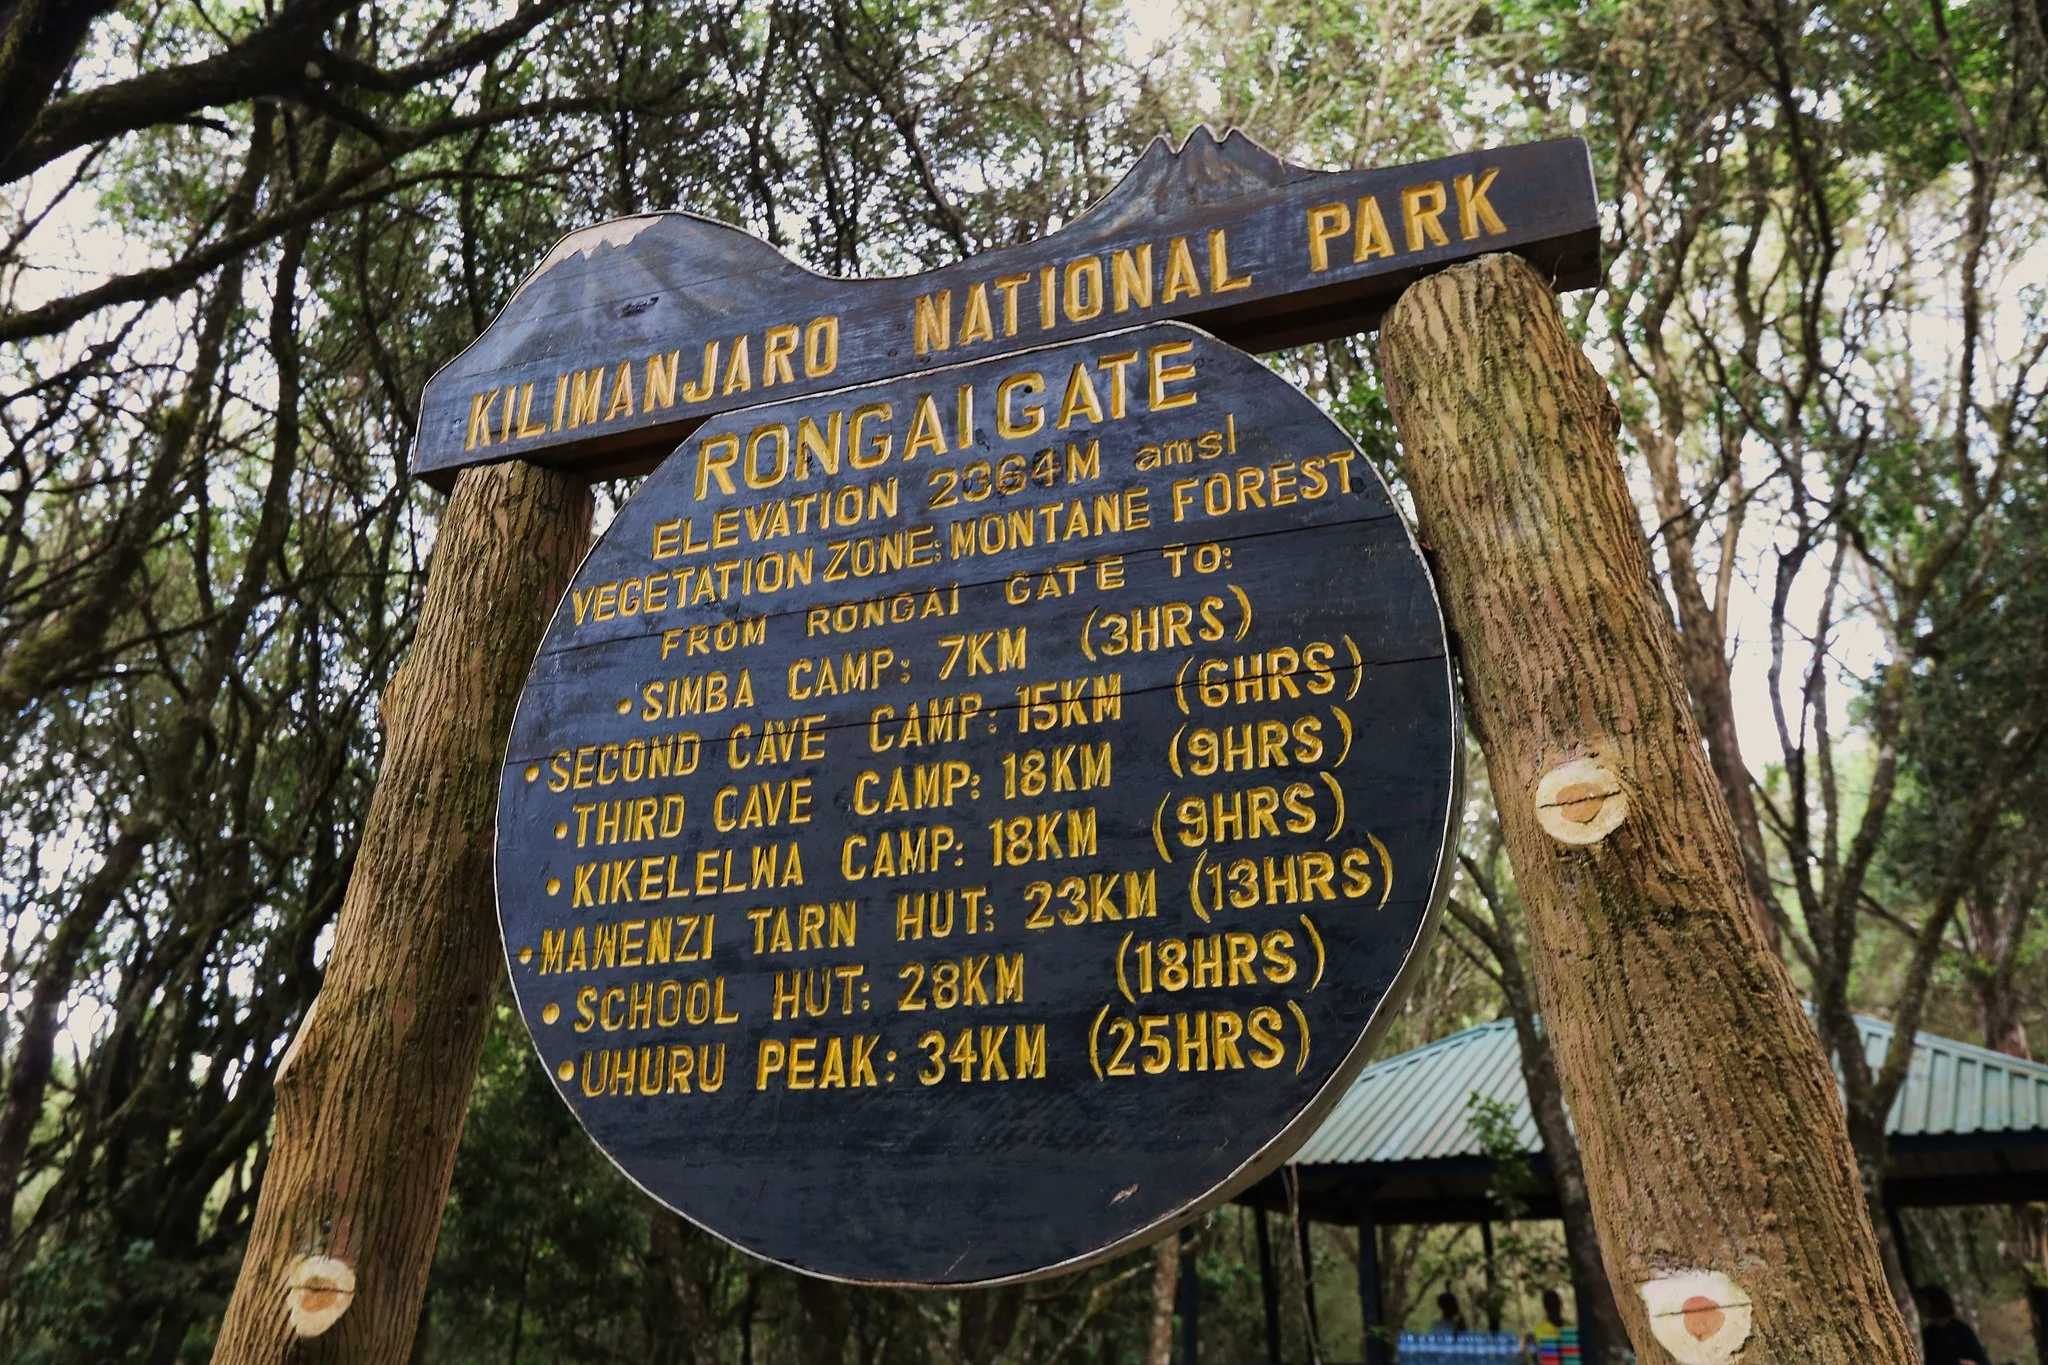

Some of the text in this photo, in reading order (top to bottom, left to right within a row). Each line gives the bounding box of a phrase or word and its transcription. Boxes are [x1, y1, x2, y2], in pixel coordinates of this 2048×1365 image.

[466, 167, 1506, 451] KILIMANJARO NATIONAL PARK
[569, 451, 1355, 628] VEGETATION ZONE: MONTANE FOREST
[652, 479, 901, 562] ELEVATION
[1136, 415, 1236, 472] amsl
[642, 584, 1253, 722] SIMBA CAMP: 7KM (3HRS)
[661, 543, 1231, 659] FROM RONGAI GATE TO:
[548, 633, 1362, 794] SECOND CAVE CAMP: 15KM (6HRS)
[574, 705, 1352, 845] THIRD CAVE CAMP: 18KM (9HRS)
[539, 836, 1393, 975] MAWENZI TARN HUT: 23KM (13HRS)
[572, 769, 1344, 908] KIKELELWA CAMP: 18KM (9HRS)
[574, 913, 1325, 1032] SCHOOL HUT: 28KM (18HRS)
[582, 1000, 1311, 1098] UHURU PEAK: 34KM (25HRS)
